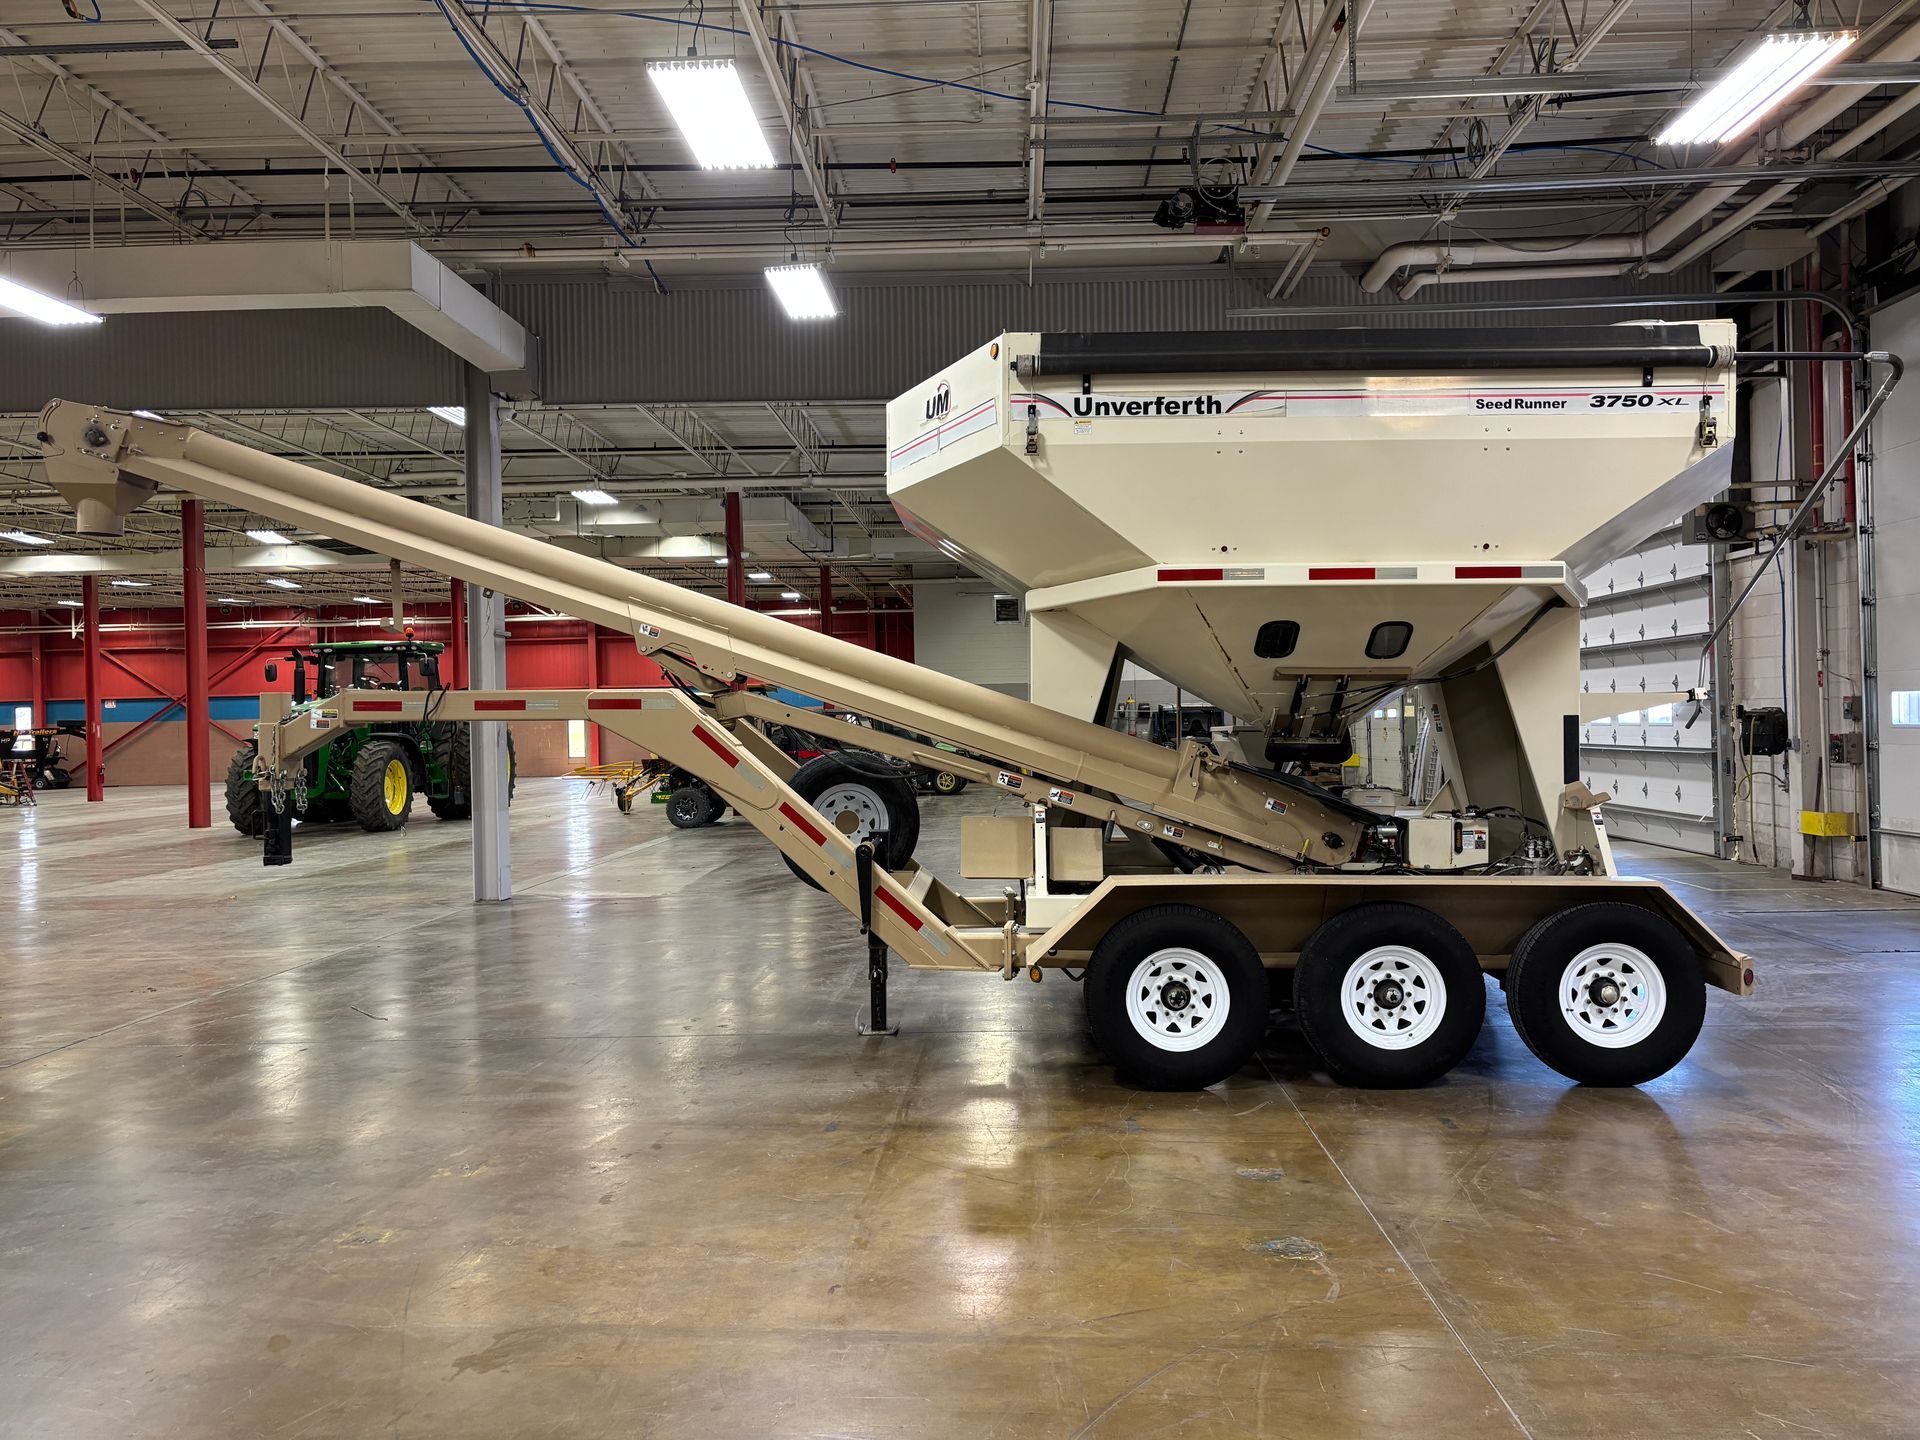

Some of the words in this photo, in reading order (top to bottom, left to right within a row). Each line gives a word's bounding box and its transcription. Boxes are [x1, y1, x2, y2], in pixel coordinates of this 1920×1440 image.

[926, 389, 950, 419] UM
[1073, 395, 1222, 416] Unverferth
[1589, 395, 1653, 407] 3750
[1657, 397, 1690, 406] XL
